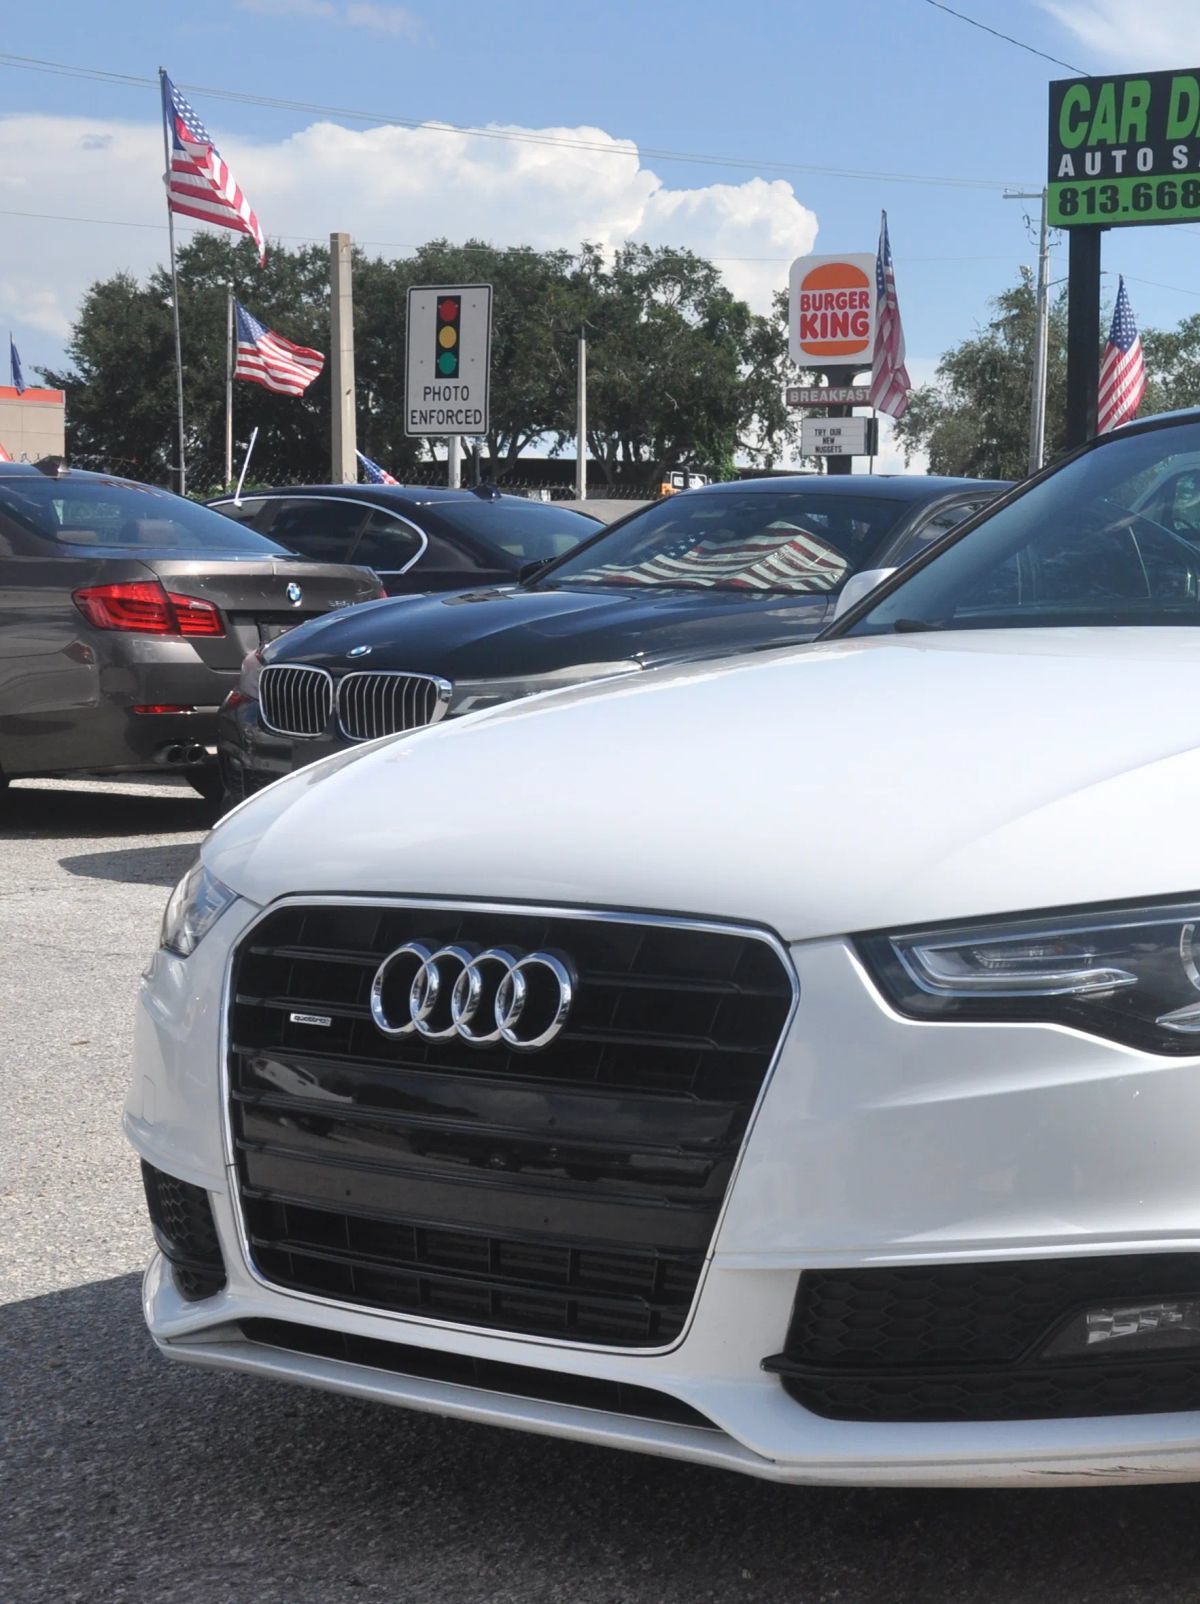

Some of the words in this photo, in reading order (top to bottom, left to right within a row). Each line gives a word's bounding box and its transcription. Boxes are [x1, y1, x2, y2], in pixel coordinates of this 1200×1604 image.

[1059, 79, 1151, 149] CAR
[1057, 147, 1153, 177] AUTO
[800, 291, 870, 312] BURGER
[800, 311, 869, 340] KING
[423, 385, 470, 402] PHOTO
[790, 388, 872, 402] BREAKFAST
[410, 408, 483, 425] ENFORCED
[814, 428, 826, 436] TRY
[829, 428, 842, 436] OUR
[822, 437, 835, 445] NEW
